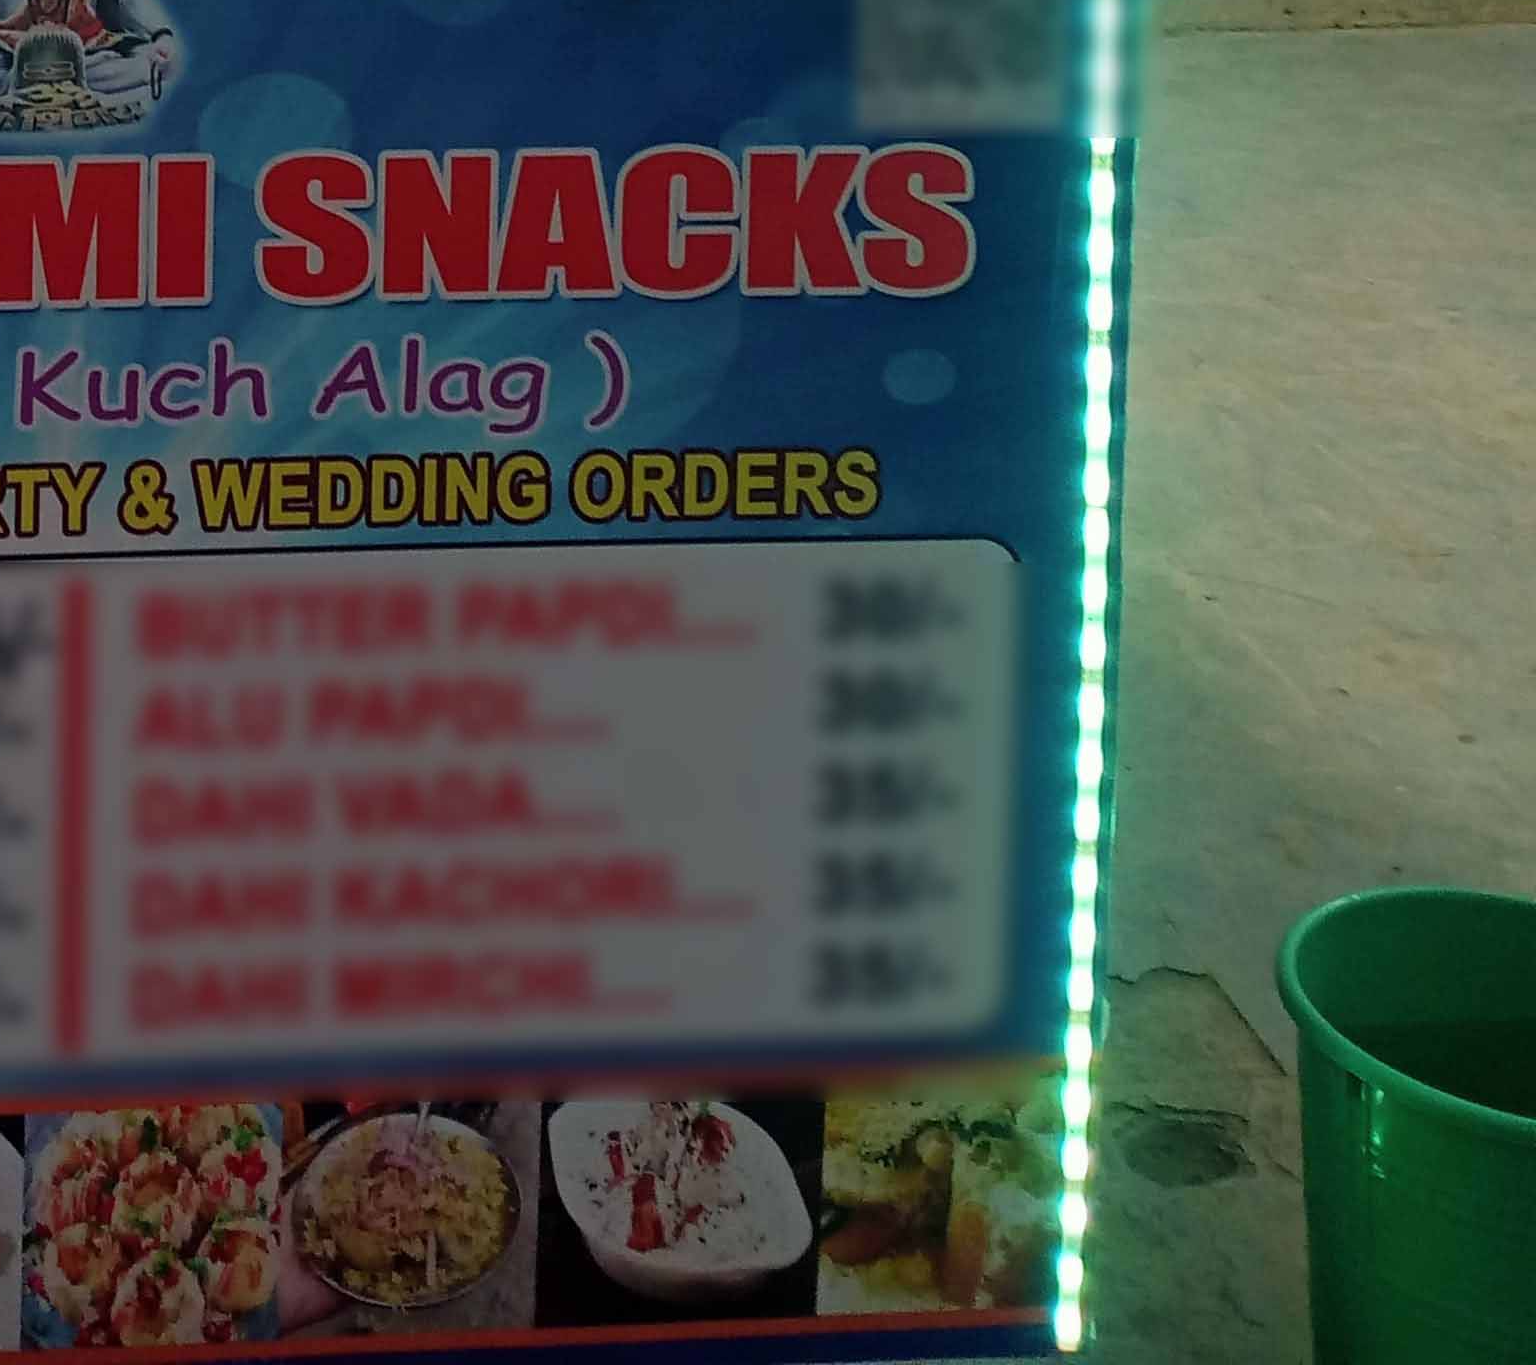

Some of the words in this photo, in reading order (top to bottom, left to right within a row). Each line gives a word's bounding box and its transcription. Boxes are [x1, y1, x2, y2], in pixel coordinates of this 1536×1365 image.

[254, 143, 976, 307] SNACKS
[14, 339, 270, 429] Kuch
[312, 331, 550, 437] Alag
[114, 461, 182, 533] &
[196, 455, 550, 531] WEDDING
[568, 449, 880, 521] ORDERS
